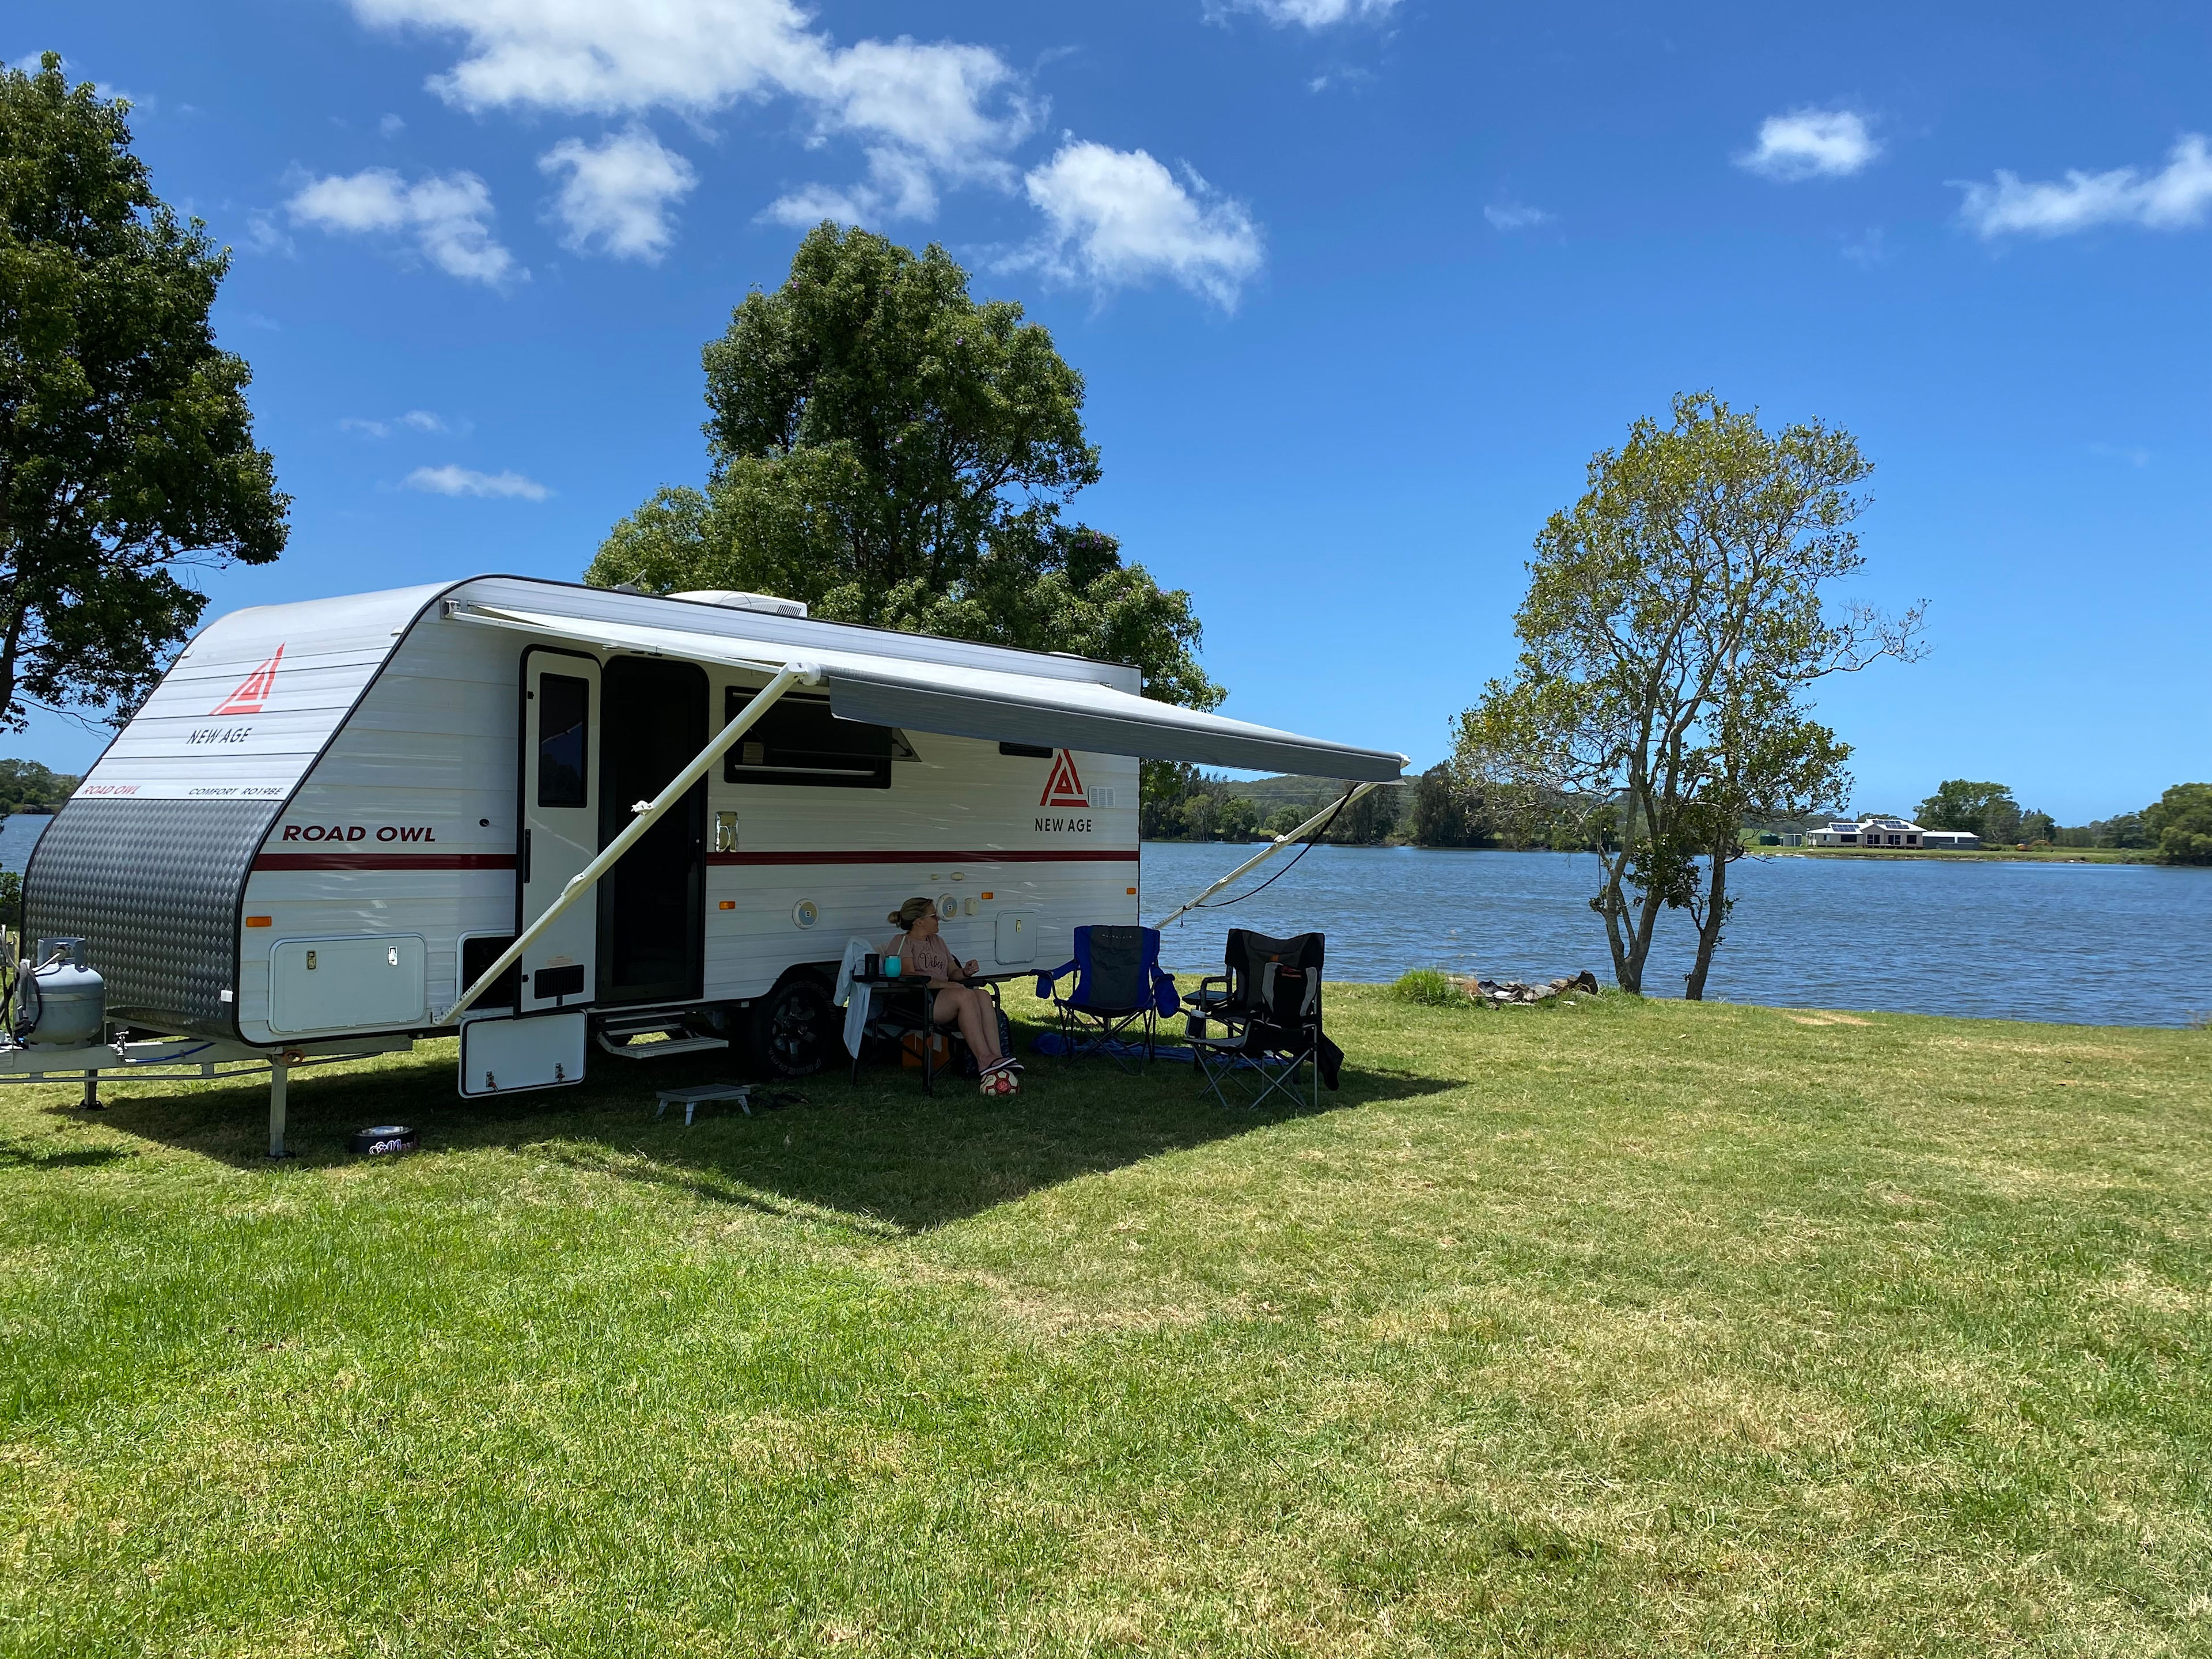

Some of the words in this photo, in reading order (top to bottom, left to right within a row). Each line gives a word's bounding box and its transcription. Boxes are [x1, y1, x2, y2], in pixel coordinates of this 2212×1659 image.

[186, 729, 222, 744] NEW
[218, 728, 252, 743] AGE
[81, 786, 115, 794] ROAD
[113, 785, 141, 794] OWL
[1035, 818, 1063, 831] NEW
[1067, 819, 1092, 832] AGE
[282, 825, 366, 841] ROAD
[376, 826, 435, 842] OWL
[920, 953, 944, 969] Vibes
